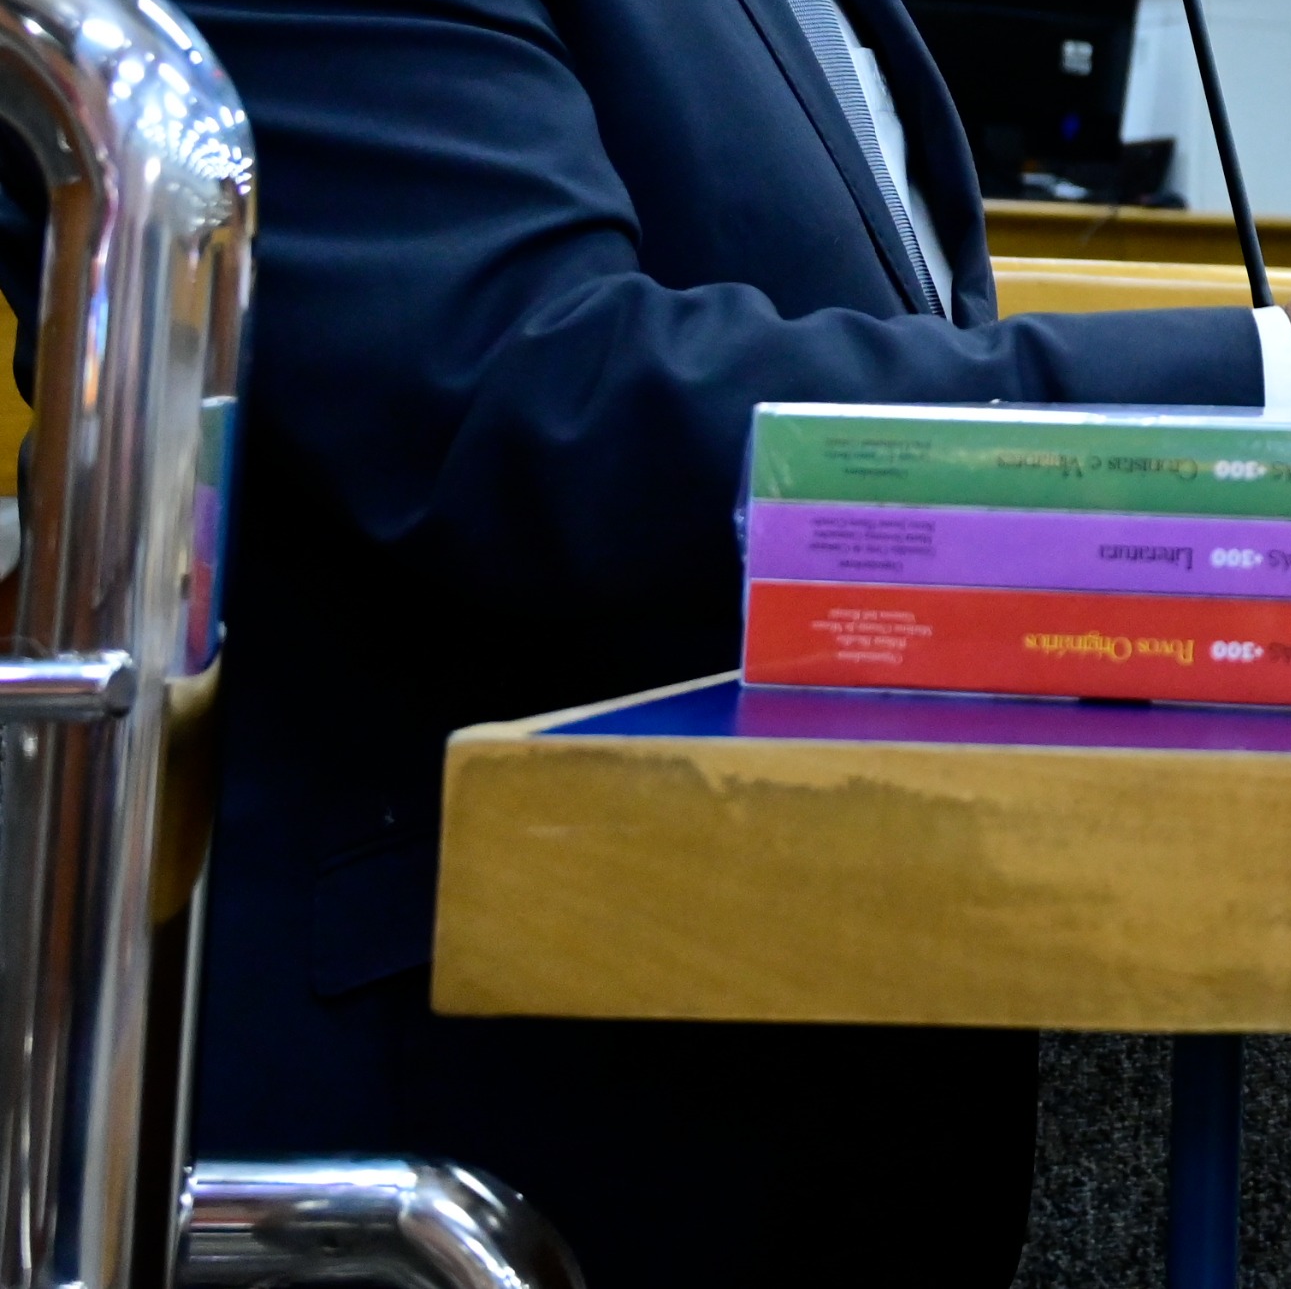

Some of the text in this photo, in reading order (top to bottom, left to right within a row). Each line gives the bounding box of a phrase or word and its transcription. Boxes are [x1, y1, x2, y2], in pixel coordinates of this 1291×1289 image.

[1108, 457, 1198, 481] Cronistas
[1098, 544, 1193, 570] Literatura
[1023, 629, 1195, 666] Povos Originários
